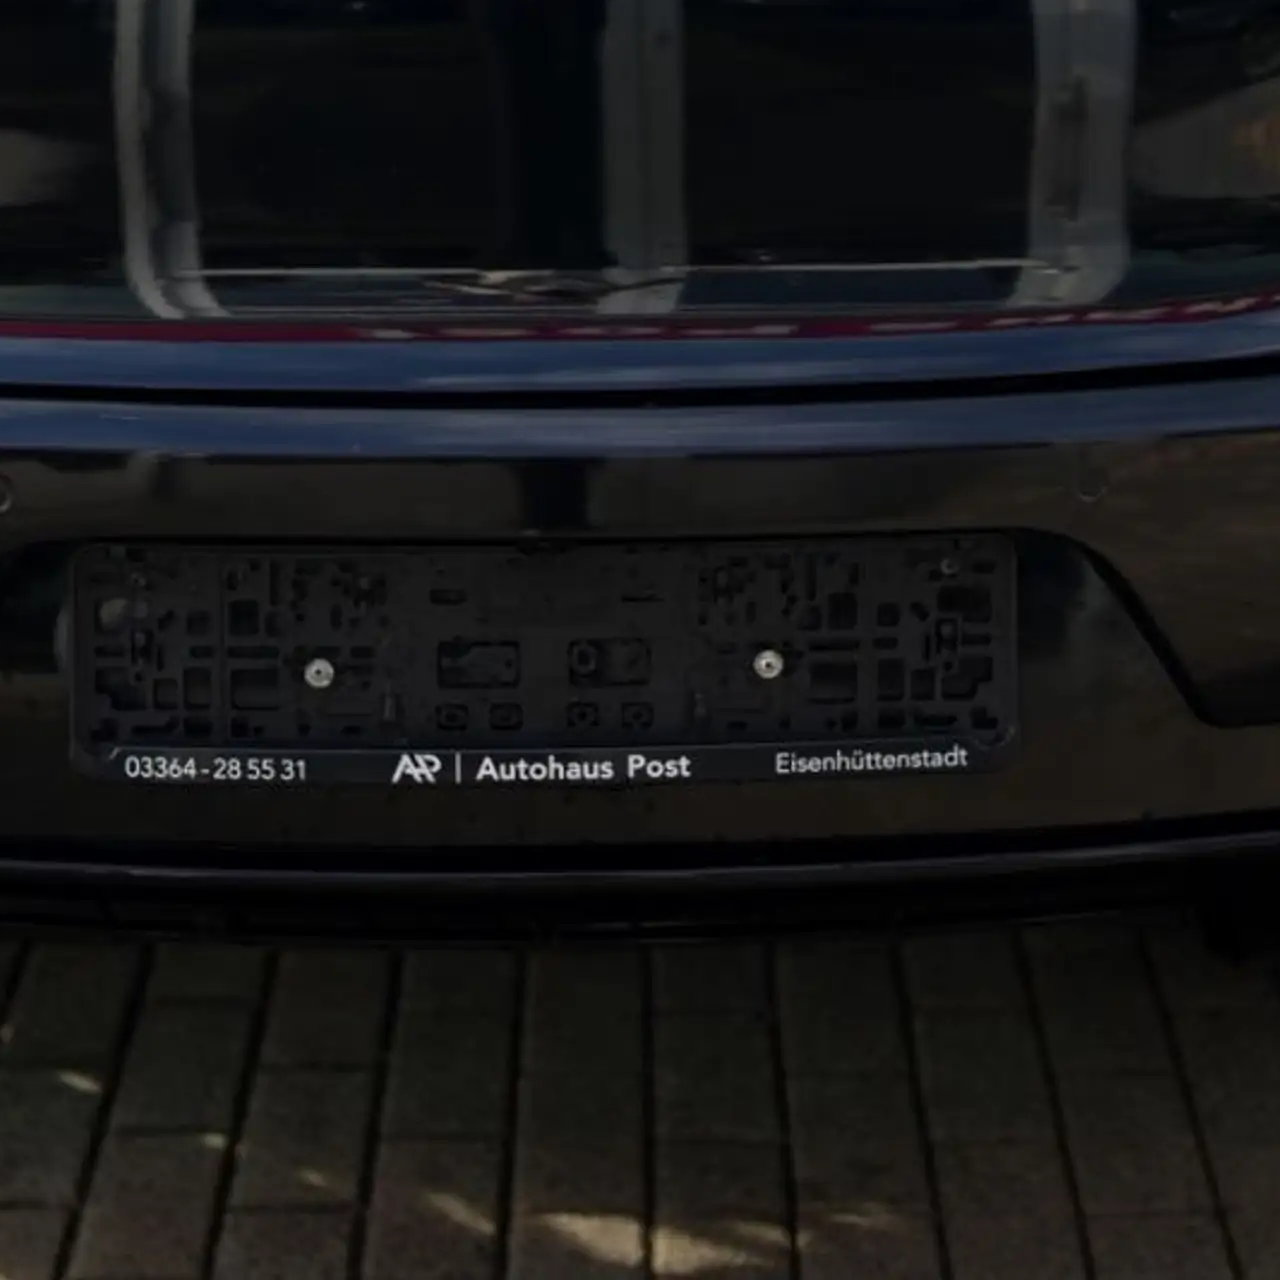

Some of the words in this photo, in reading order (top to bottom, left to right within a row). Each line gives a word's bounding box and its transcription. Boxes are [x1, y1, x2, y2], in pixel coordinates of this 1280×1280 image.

[476, 755, 614, 781] Autohaus
[627, 754, 692, 778] Post
[775, 743, 969, 775] Eisenhüttenstadt
